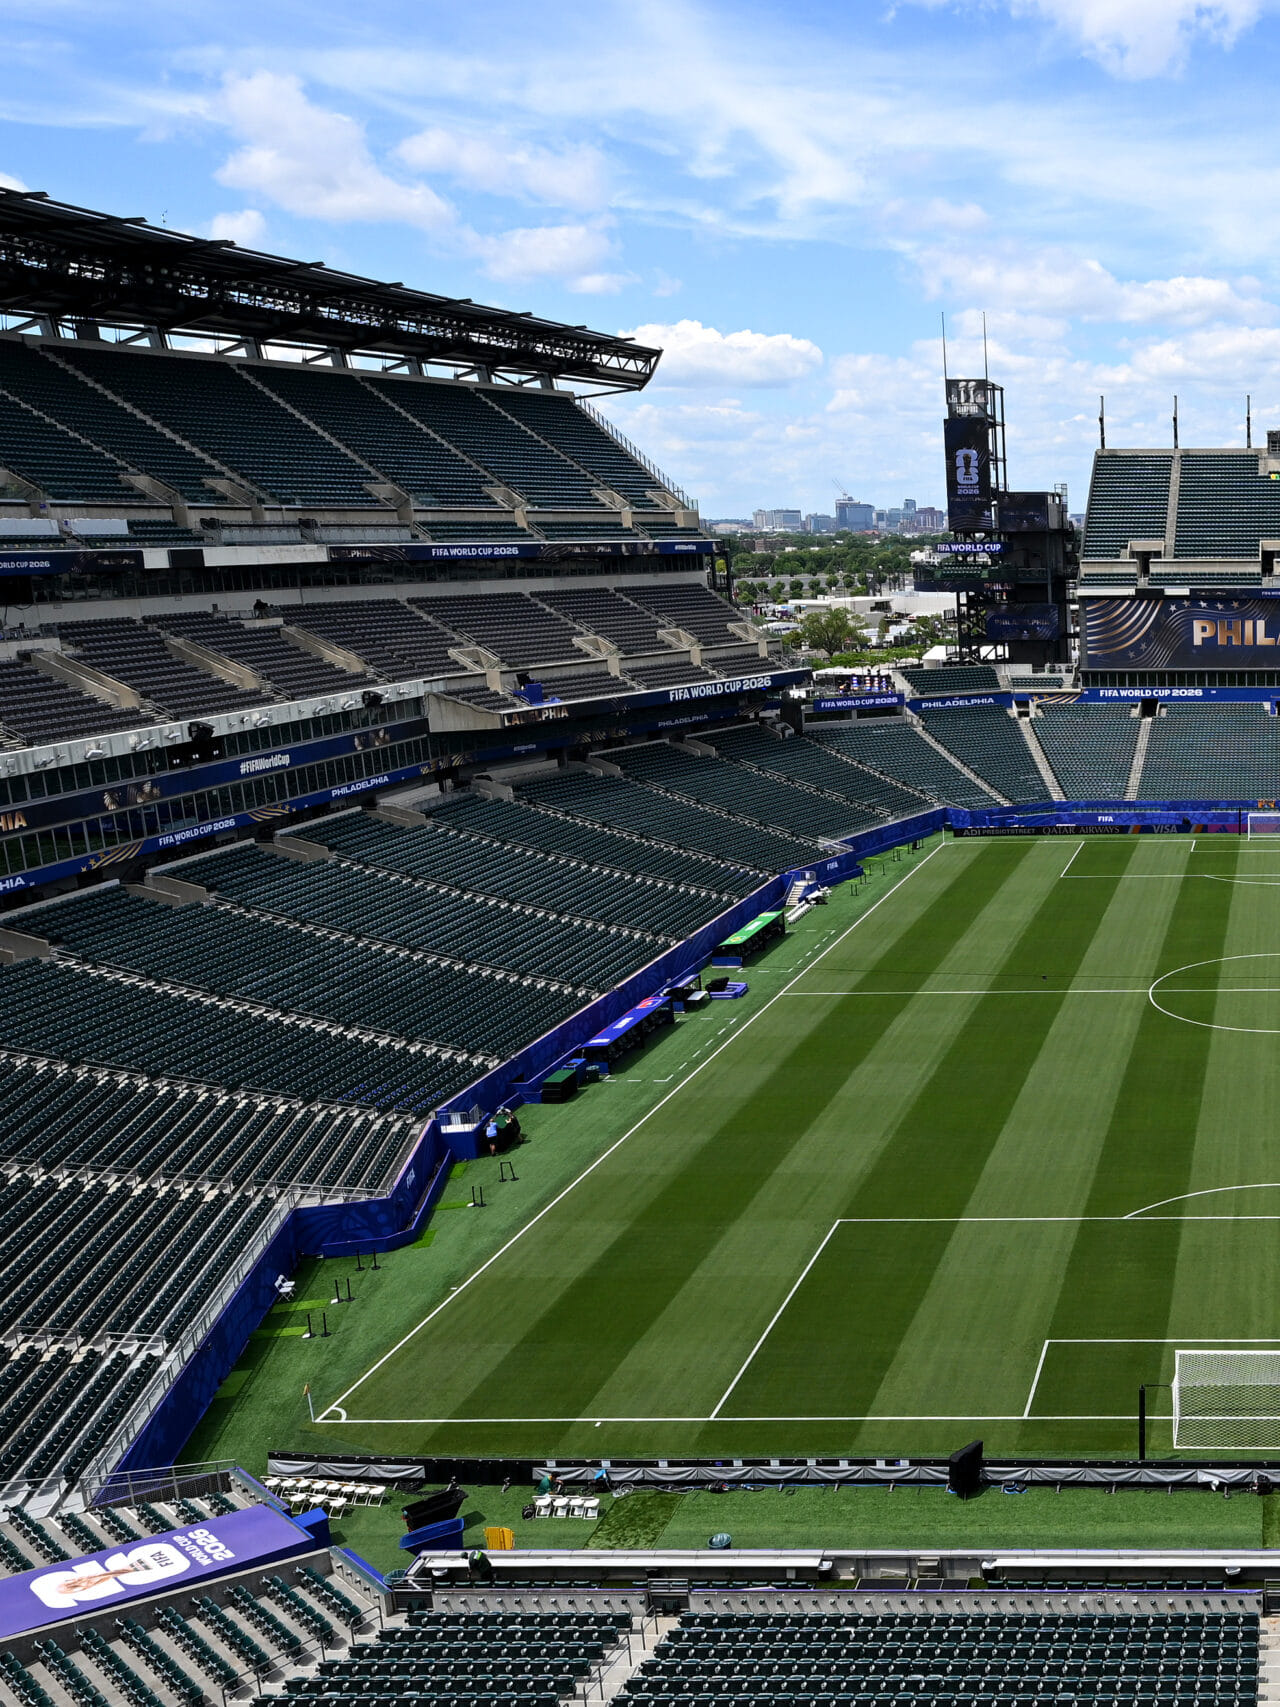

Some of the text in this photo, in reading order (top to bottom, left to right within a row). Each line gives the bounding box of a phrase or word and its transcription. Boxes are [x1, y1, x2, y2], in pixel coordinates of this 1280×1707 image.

[432, 546, 519, 557] FIFA WORLD CUP 2026
[937, 543, 1001, 552] FIFA WORLD CUP
[29, 560, 51, 568] 2026
[670, 676, 771, 702] FIFA WORLD CUP 2026
[1100, 689, 1203, 697] FIFA WORLD CUP 2026
[821, 701, 836, 709] FIFA
[837, 699, 860, 707] WORLD
[922, 697, 994, 709] PHILADELPHIA
[658, 714, 709, 728] PHILADELPHIA
[240, 754, 291, 774] #FIFAWorldCup
[331, 775, 389, 798] PHILADELPHIA
[159, 819, 236, 847] FIFA WORLD CUP 2026
[1042, 825, 1120, 835] QATAR AIRWAYS
[1152, 824, 1178, 834] VISA
[826, 860, 839, 871] FIFA
[172, 1535, 214, 1566] WORLD CUP
[188, 1528, 235, 1562] 2026
[150, 1550, 174, 1567] FIFA
